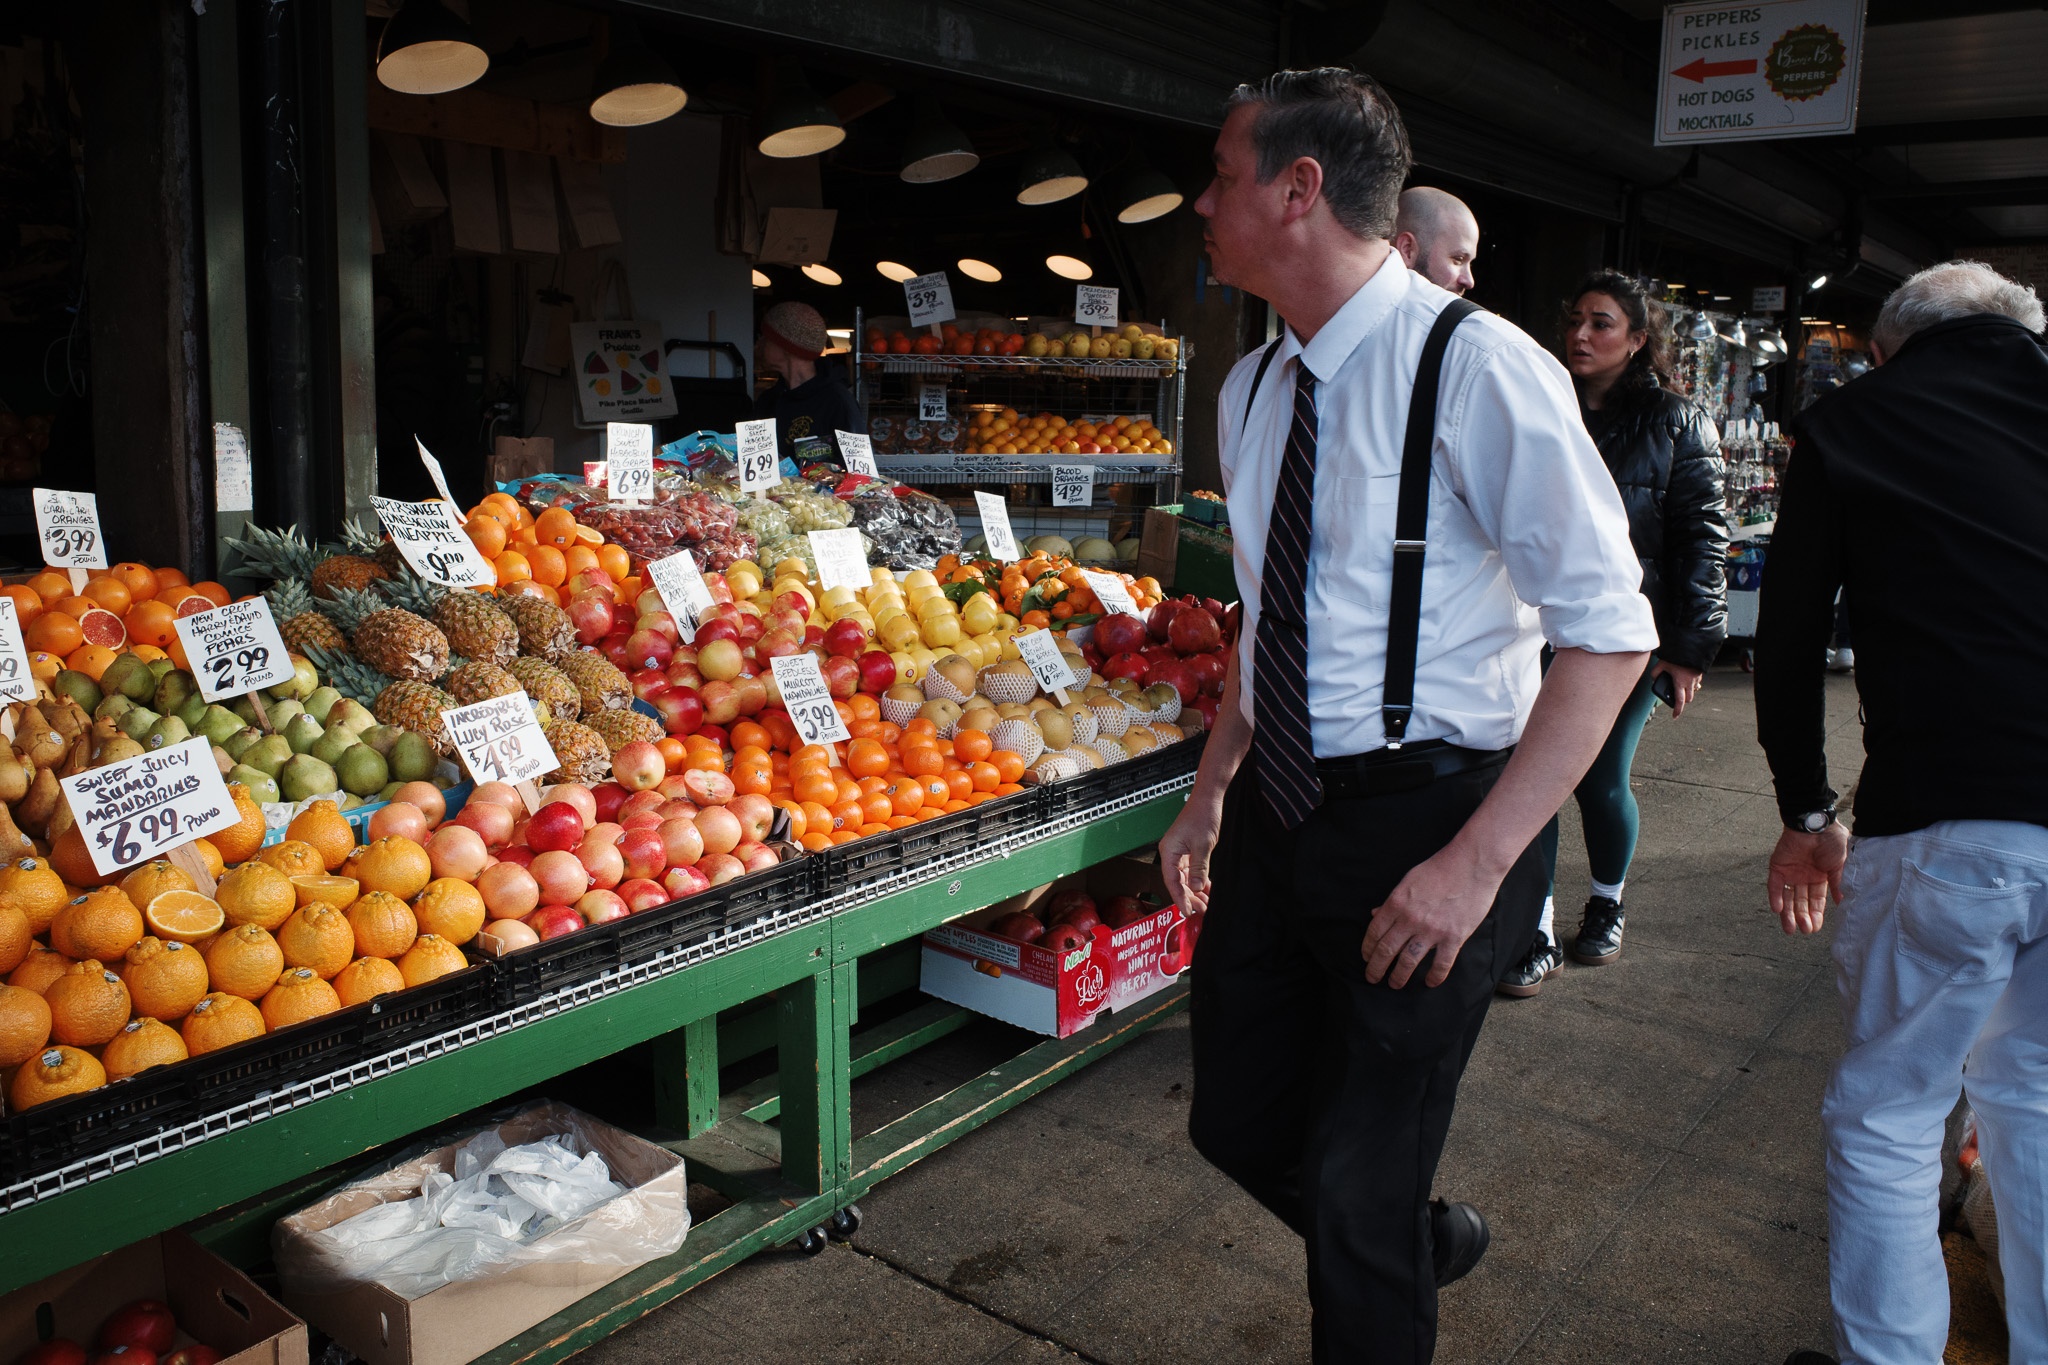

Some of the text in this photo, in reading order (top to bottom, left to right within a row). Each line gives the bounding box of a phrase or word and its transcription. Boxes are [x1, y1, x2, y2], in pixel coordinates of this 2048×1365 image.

[1684, 8, 1761, 28] PEPPERS
[1682, 31, 1760, 51] PICKLES
[1782, 71, 1826, 82] PEPPERS
[1678, 88, 1755, 106] HOT DOGS
[1678, 113, 1754, 131] MOCKTAILS
[599, 330, 642, 339] FRANK'S
[604, 343, 641, 352] Produce
[611, 425, 646, 439] CRUNCHY
[623, 457, 650, 468] GRAPES
[1055, 467, 1081, 475] BLOOD
[370, 496, 444, 517] SUPER SWEET
[52, 515, 94, 524] ORANGES
[386, 523, 461, 543] PINEAPPLE
[71, 556, 97, 566] POUND
[450, 568, 478, 583] EACH
[191, 601, 251, 626] NEW CROP
[192, 619, 227, 637] HARRY
[235, 610, 262, 625] DAVID
[203, 622, 254, 644] COMICE
[204, 633, 256, 656] PEARS
[777, 657, 806, 668] SWEET
[240, 672, 274, 688] POUND
[776, 666, 817, 681] SEEDLESS
[783, 677, 817, 690] MURCOT
[450, 697, 522, 728] INCREDIBLE
[454, 724, 489, 746] LUCY
[820, 730, 840, 742] POUND
[75, 750, 189, 793] SWEET JUICY
[509, 758, 540, 780] POUND
[95, 774, 158, 805] SUMO
[85, 775, 201, 825] MANDARINES
[183, 807, 221, 833] POUND
[953, 930, 976, 944] APPLES
[1111, 911, 1173, 948] NATURALLY RED
[1032, 950, 1054, 964] CHELAN
[1064, 940, 1093, 972] NEW!
[1117, 944, 1139, 962] INSIDE
[1156, 934, 1161, 944] A
[1128, 952, 1157, 974] HINT OF
[1076, 968, 1104, 1007] Lucy
[1121, 970, 1153, 996] BERRY
